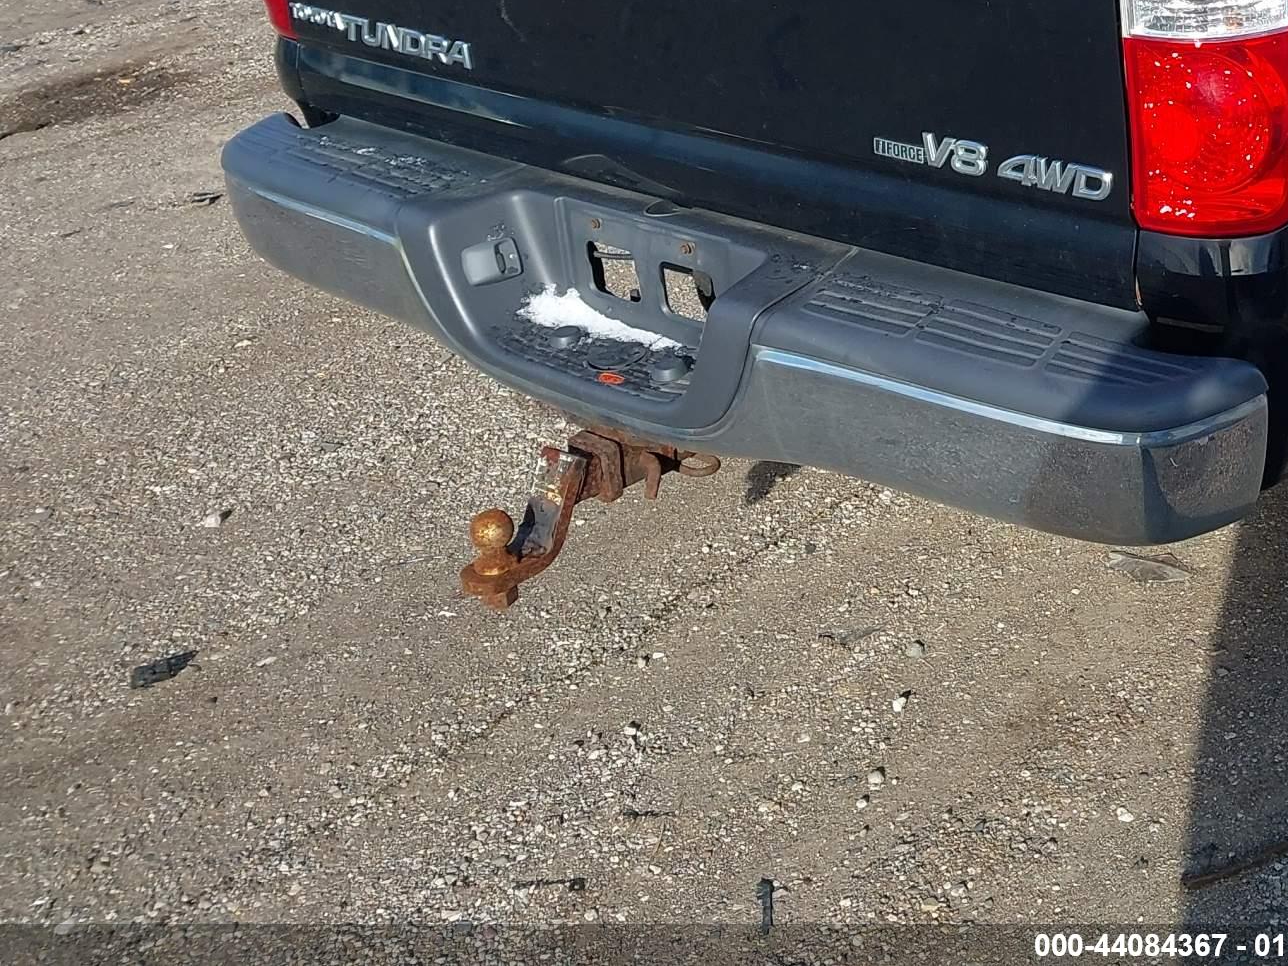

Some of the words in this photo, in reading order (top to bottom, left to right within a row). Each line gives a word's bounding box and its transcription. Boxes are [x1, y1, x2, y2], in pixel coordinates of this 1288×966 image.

[342, 14, 473, 70] TUNDRA
[922, 132, 989, 176] V8
[997, 154, 1113, 201] 4WD
